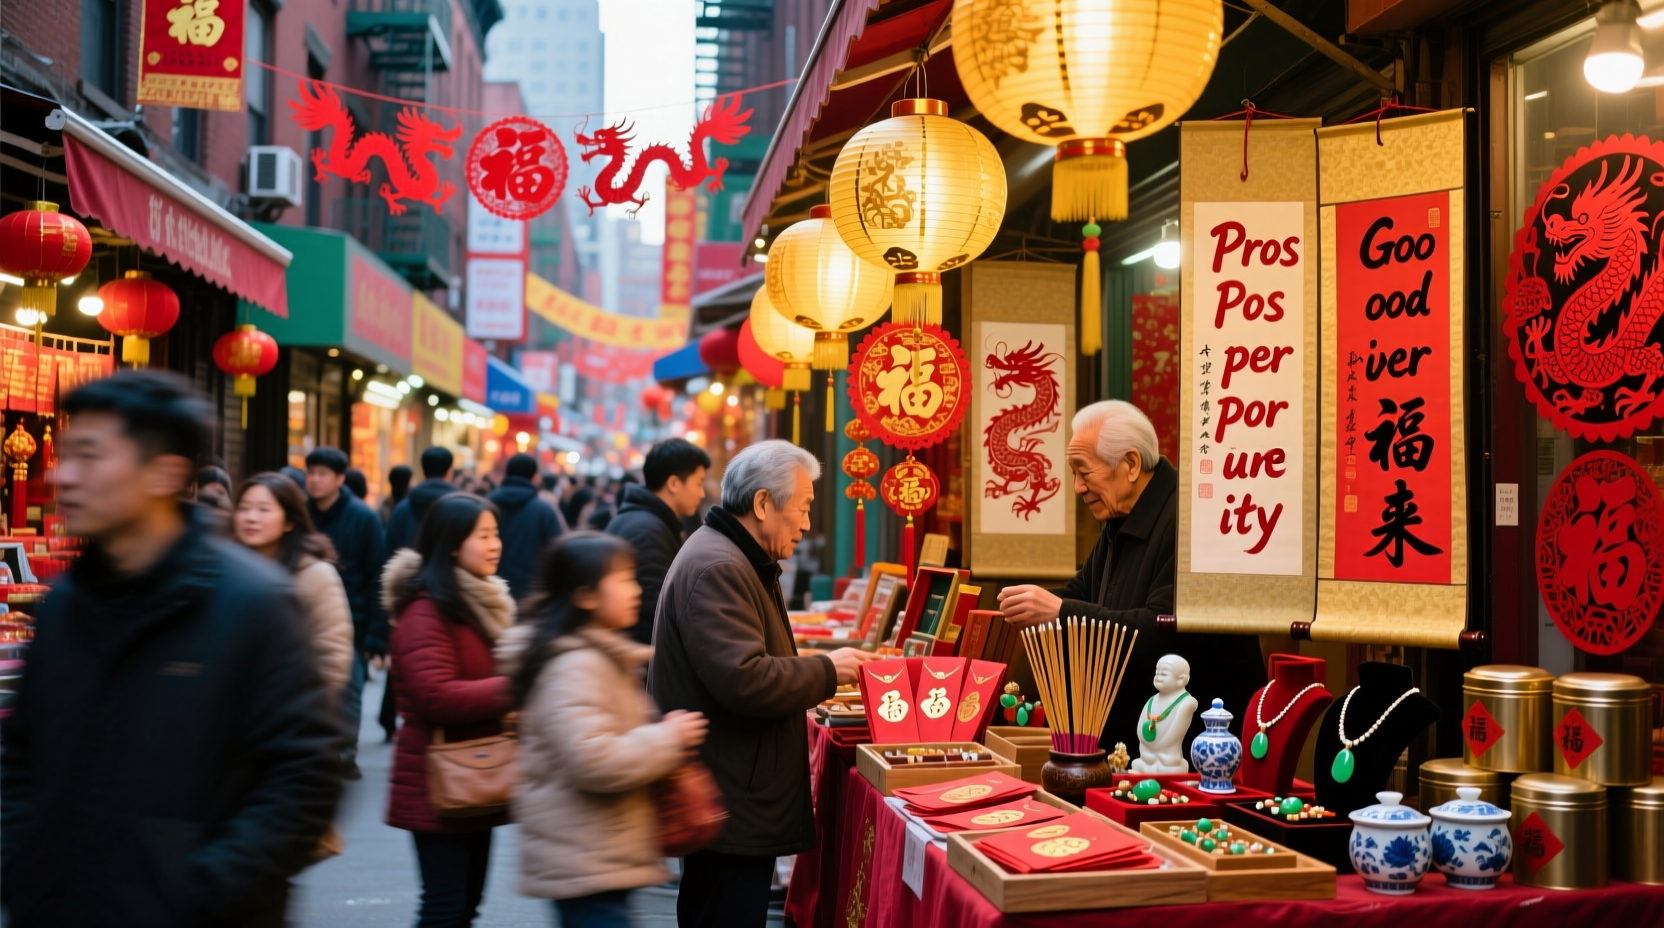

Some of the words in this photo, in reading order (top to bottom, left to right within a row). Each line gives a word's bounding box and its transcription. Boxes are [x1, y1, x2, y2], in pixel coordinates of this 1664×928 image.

[166, 0, 225, 47] 福
[480, 128, 555, 203] 福
[1210, 221, 1300, 273] Pros
[1359, 216, 1436, 270] Goo
[1214, 280, 1285, 329] Pos
[1365, 270, 1433, 321] ood
[876, 345, 943, 419] 福
[1221, 345, 1294, 389] per
[1363, 396, 1444, 568] 福来
[1220, 493, 1284, 554] ity
[1557, 475, 1647, 611] 福
[1562, 725, 1584, 753] 福
